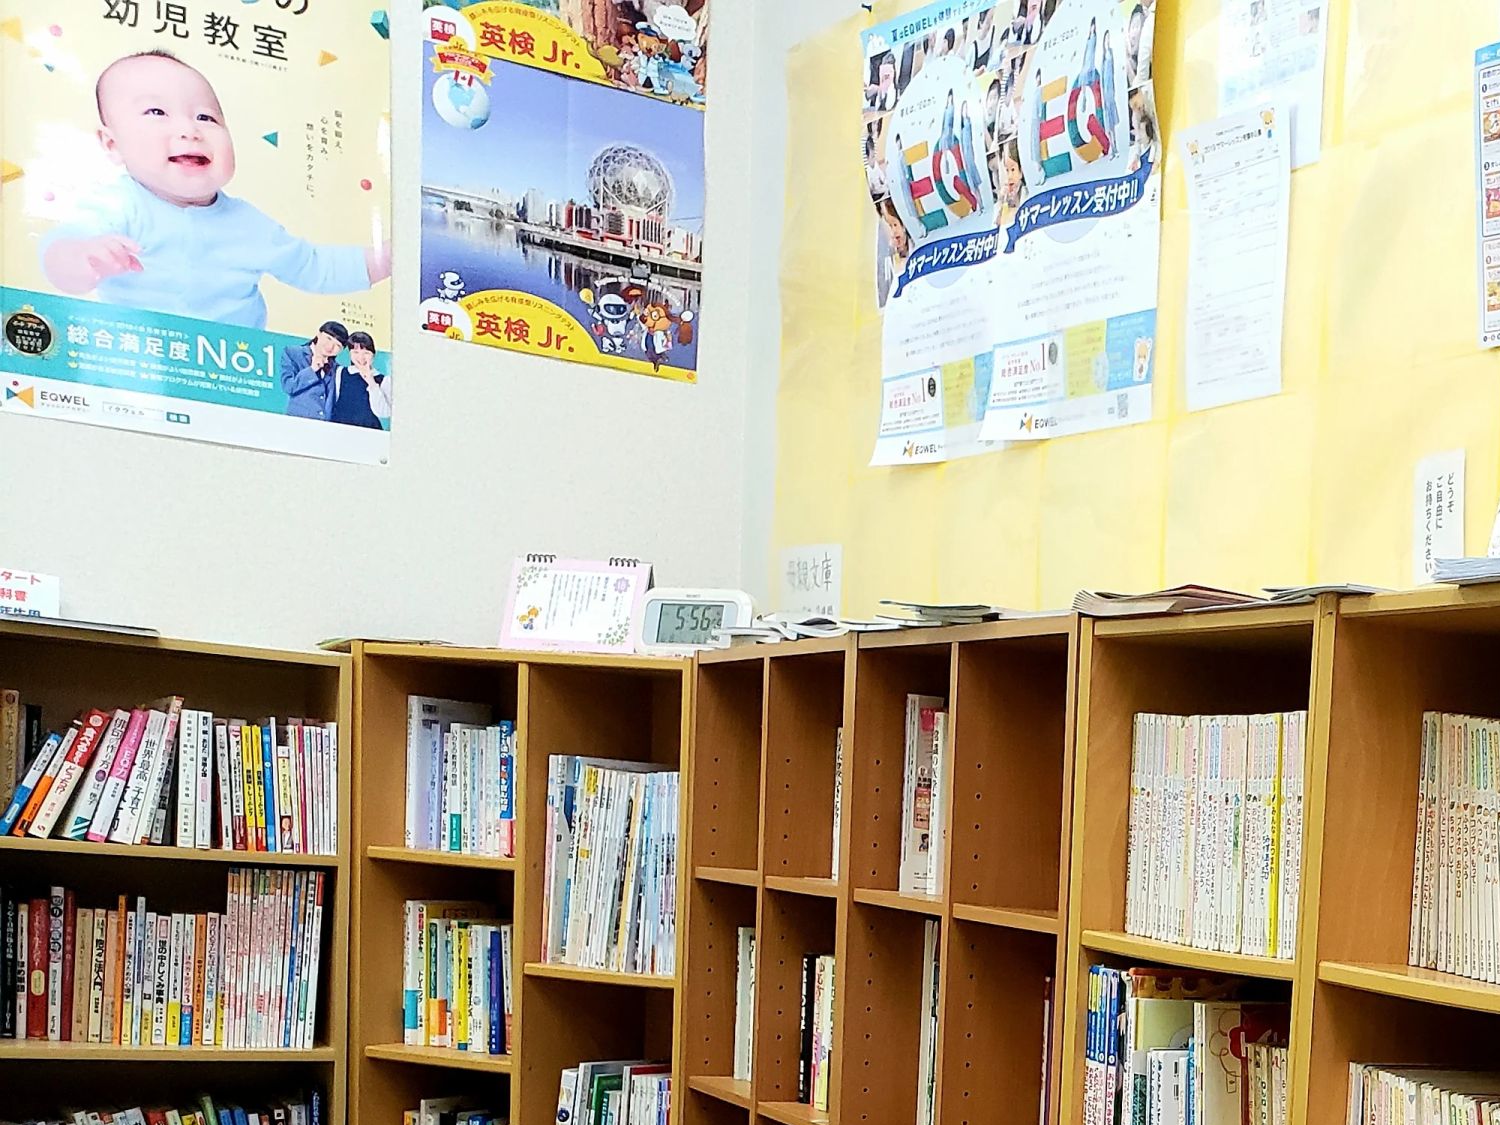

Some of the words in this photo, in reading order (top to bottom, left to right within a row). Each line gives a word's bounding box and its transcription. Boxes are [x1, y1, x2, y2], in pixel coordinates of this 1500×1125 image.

[102, 0, 289, 62] 幼児教室
[480, 22, 535, 58] 英検
[543, 41, 580, 69] Jr.
[1018, 183, 1139, 232] サマーレッスン受付中!!
[67, 324, 190, 361] 総合満足度
[196, 335, 274, 377] No.1
[476, 312, 531, 344] 英検
[538, 326, 574, 352] Jr.
[40, 391, 90, 407] EQWEL
